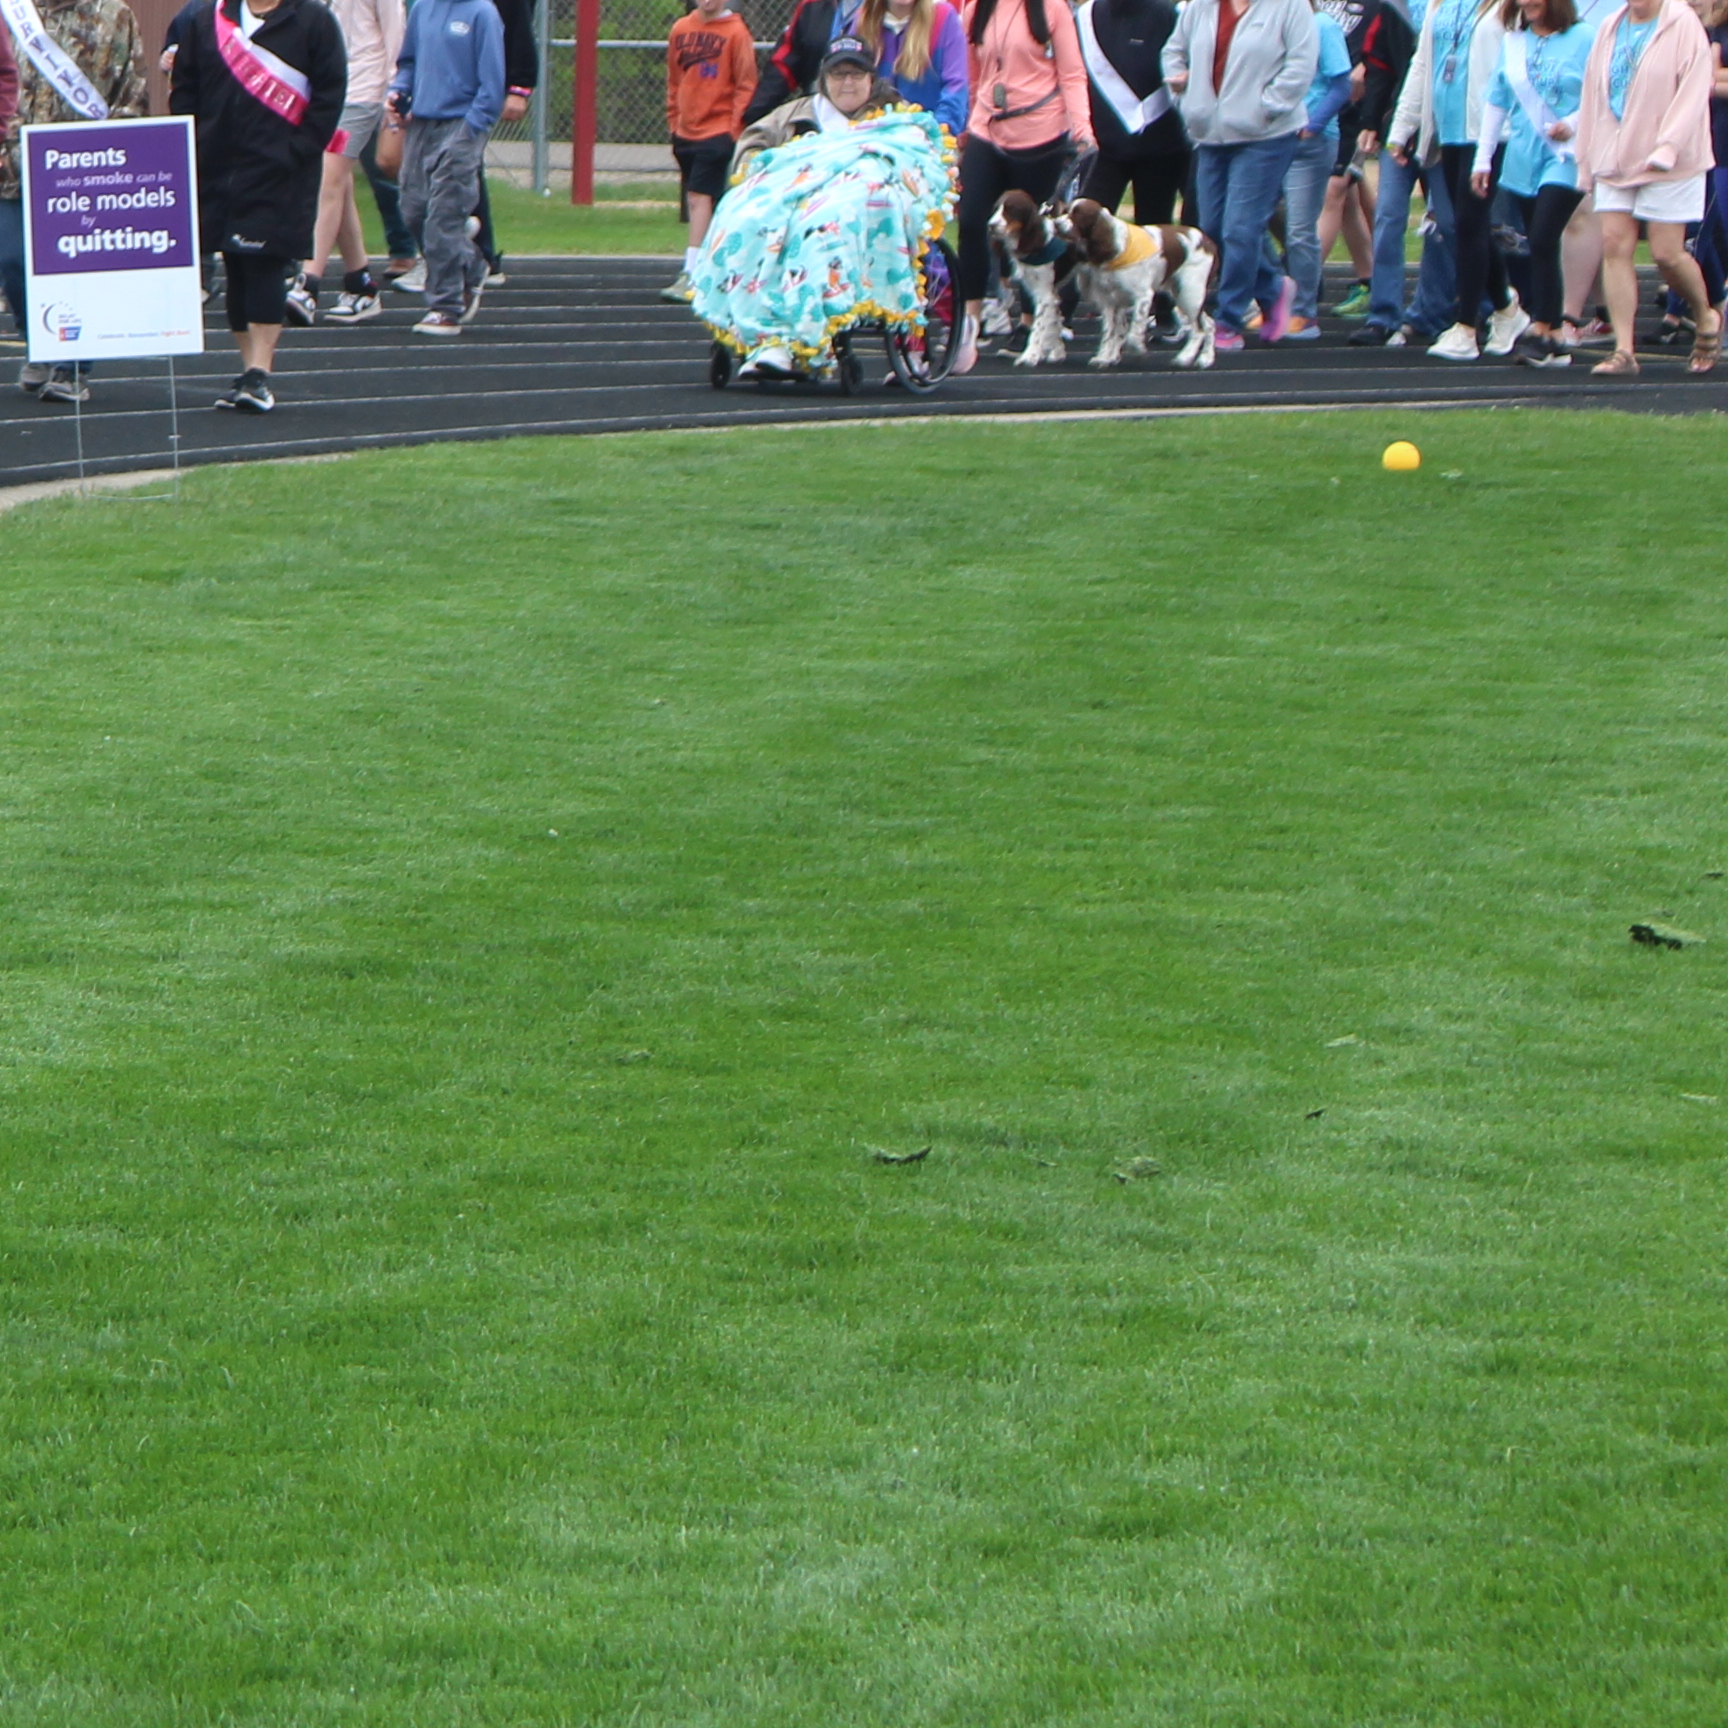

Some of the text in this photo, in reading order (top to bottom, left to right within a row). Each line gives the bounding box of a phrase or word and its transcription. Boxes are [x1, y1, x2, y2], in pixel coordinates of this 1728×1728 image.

[45, 147, 126, 170] Parents
[55, 171, 173, 187] who smoke can be
[47, 186, 176, 214] role models
[80, 215, 97, 228] by
[57, 226, 177, 259] quitting.
